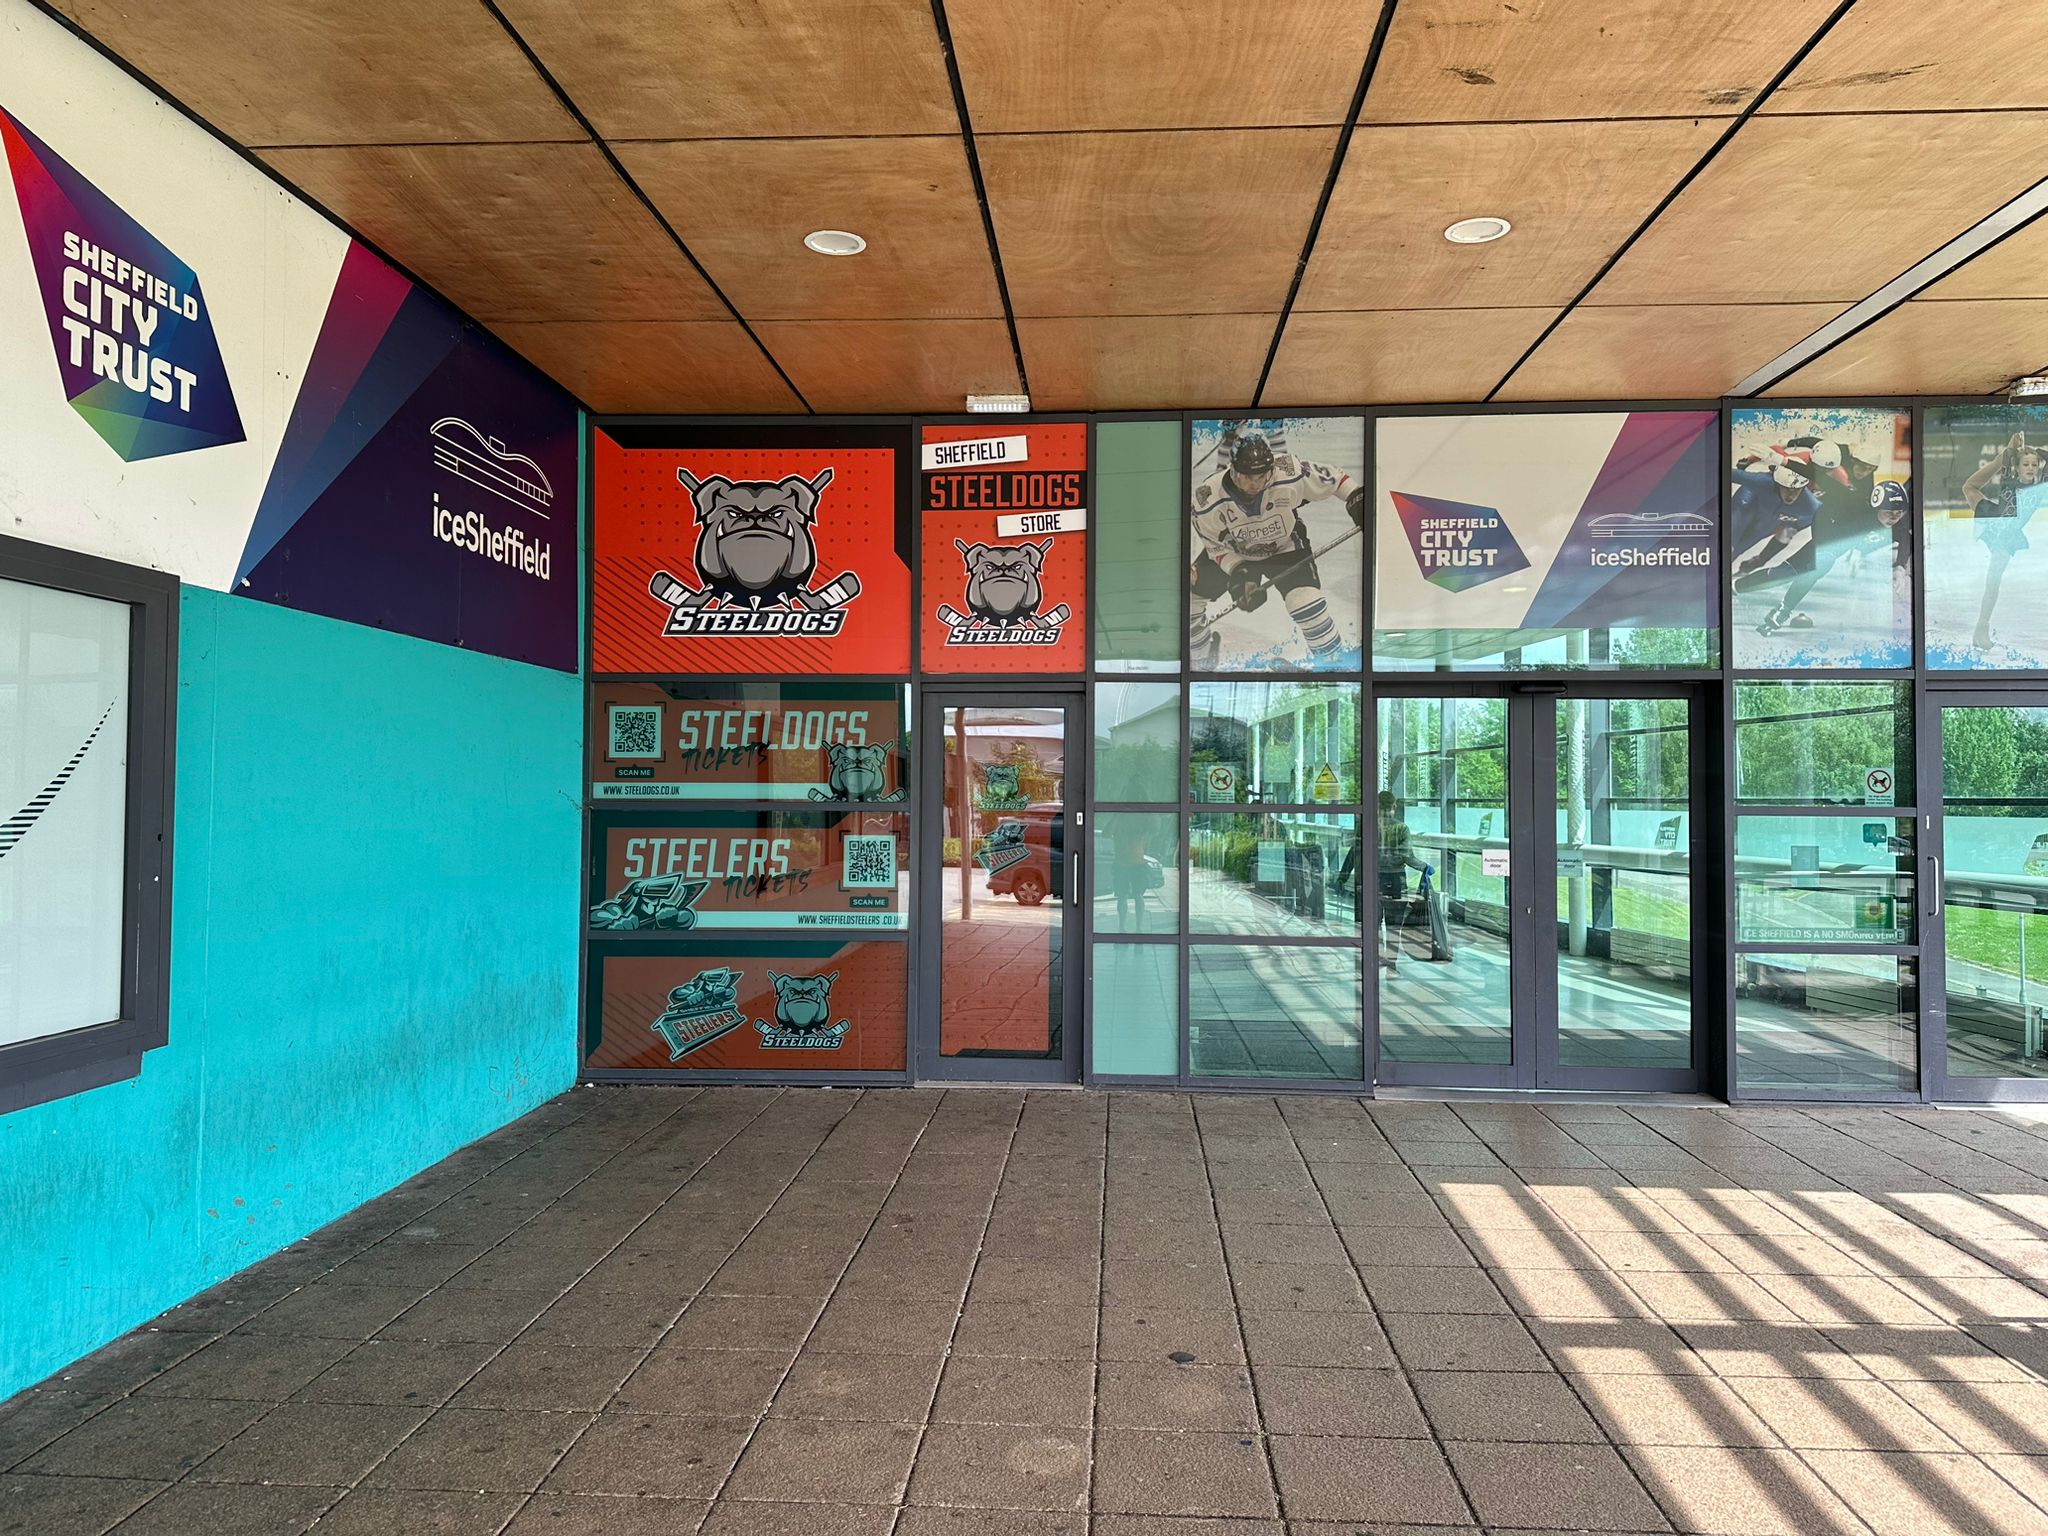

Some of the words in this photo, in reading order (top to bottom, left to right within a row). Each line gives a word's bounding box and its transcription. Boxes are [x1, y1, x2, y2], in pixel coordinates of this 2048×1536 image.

[63, 231, 198, 321] SHEFFIELD
[63, 266, 158, 347] CITY
[63, 315, 197, 413] TRUST
[935, 441, 1006, 464] SHEFFIELD
[930, 474, 1080, 508] STEELDOGS
[1021, 513, 1062, 533] STORE
[1420, 518, 1498, 529] SHEFFIELD
[432, 493, 551, 581] iceSheffield
[1420, 530, 1473, 548] CITY
[1420, 549, 1498, 566] TRUST
[1591, 547, 1711, 567] iceSheffield
[670, 607, 844, 633] STEELDOGS
[950, 625, 1059, 644] STEELDOGS
[678, 710, 869, 750] STEELDOGS
[681, 742, 772, 776] TICKETS
[618, 768, 639, 777] SCAN
[640, 768, 652, 777] ME
[623, 838, 791, 880] STEELERS
[723, 869, 812, 905] TICKETS
[819, 915, 880, 925] SHEFFIELDSTEELERS
[1758, 929, 1801, 938] SHEFFIELD
[1803, 930, 1812, 939] IS
[1813, 930, 1820, 939] A
[1821, 930, 1834, 939] NO
[673, 1011, 735, 1043] STEELERS
[763, 1034, 841, 1048] STEELDOGS
